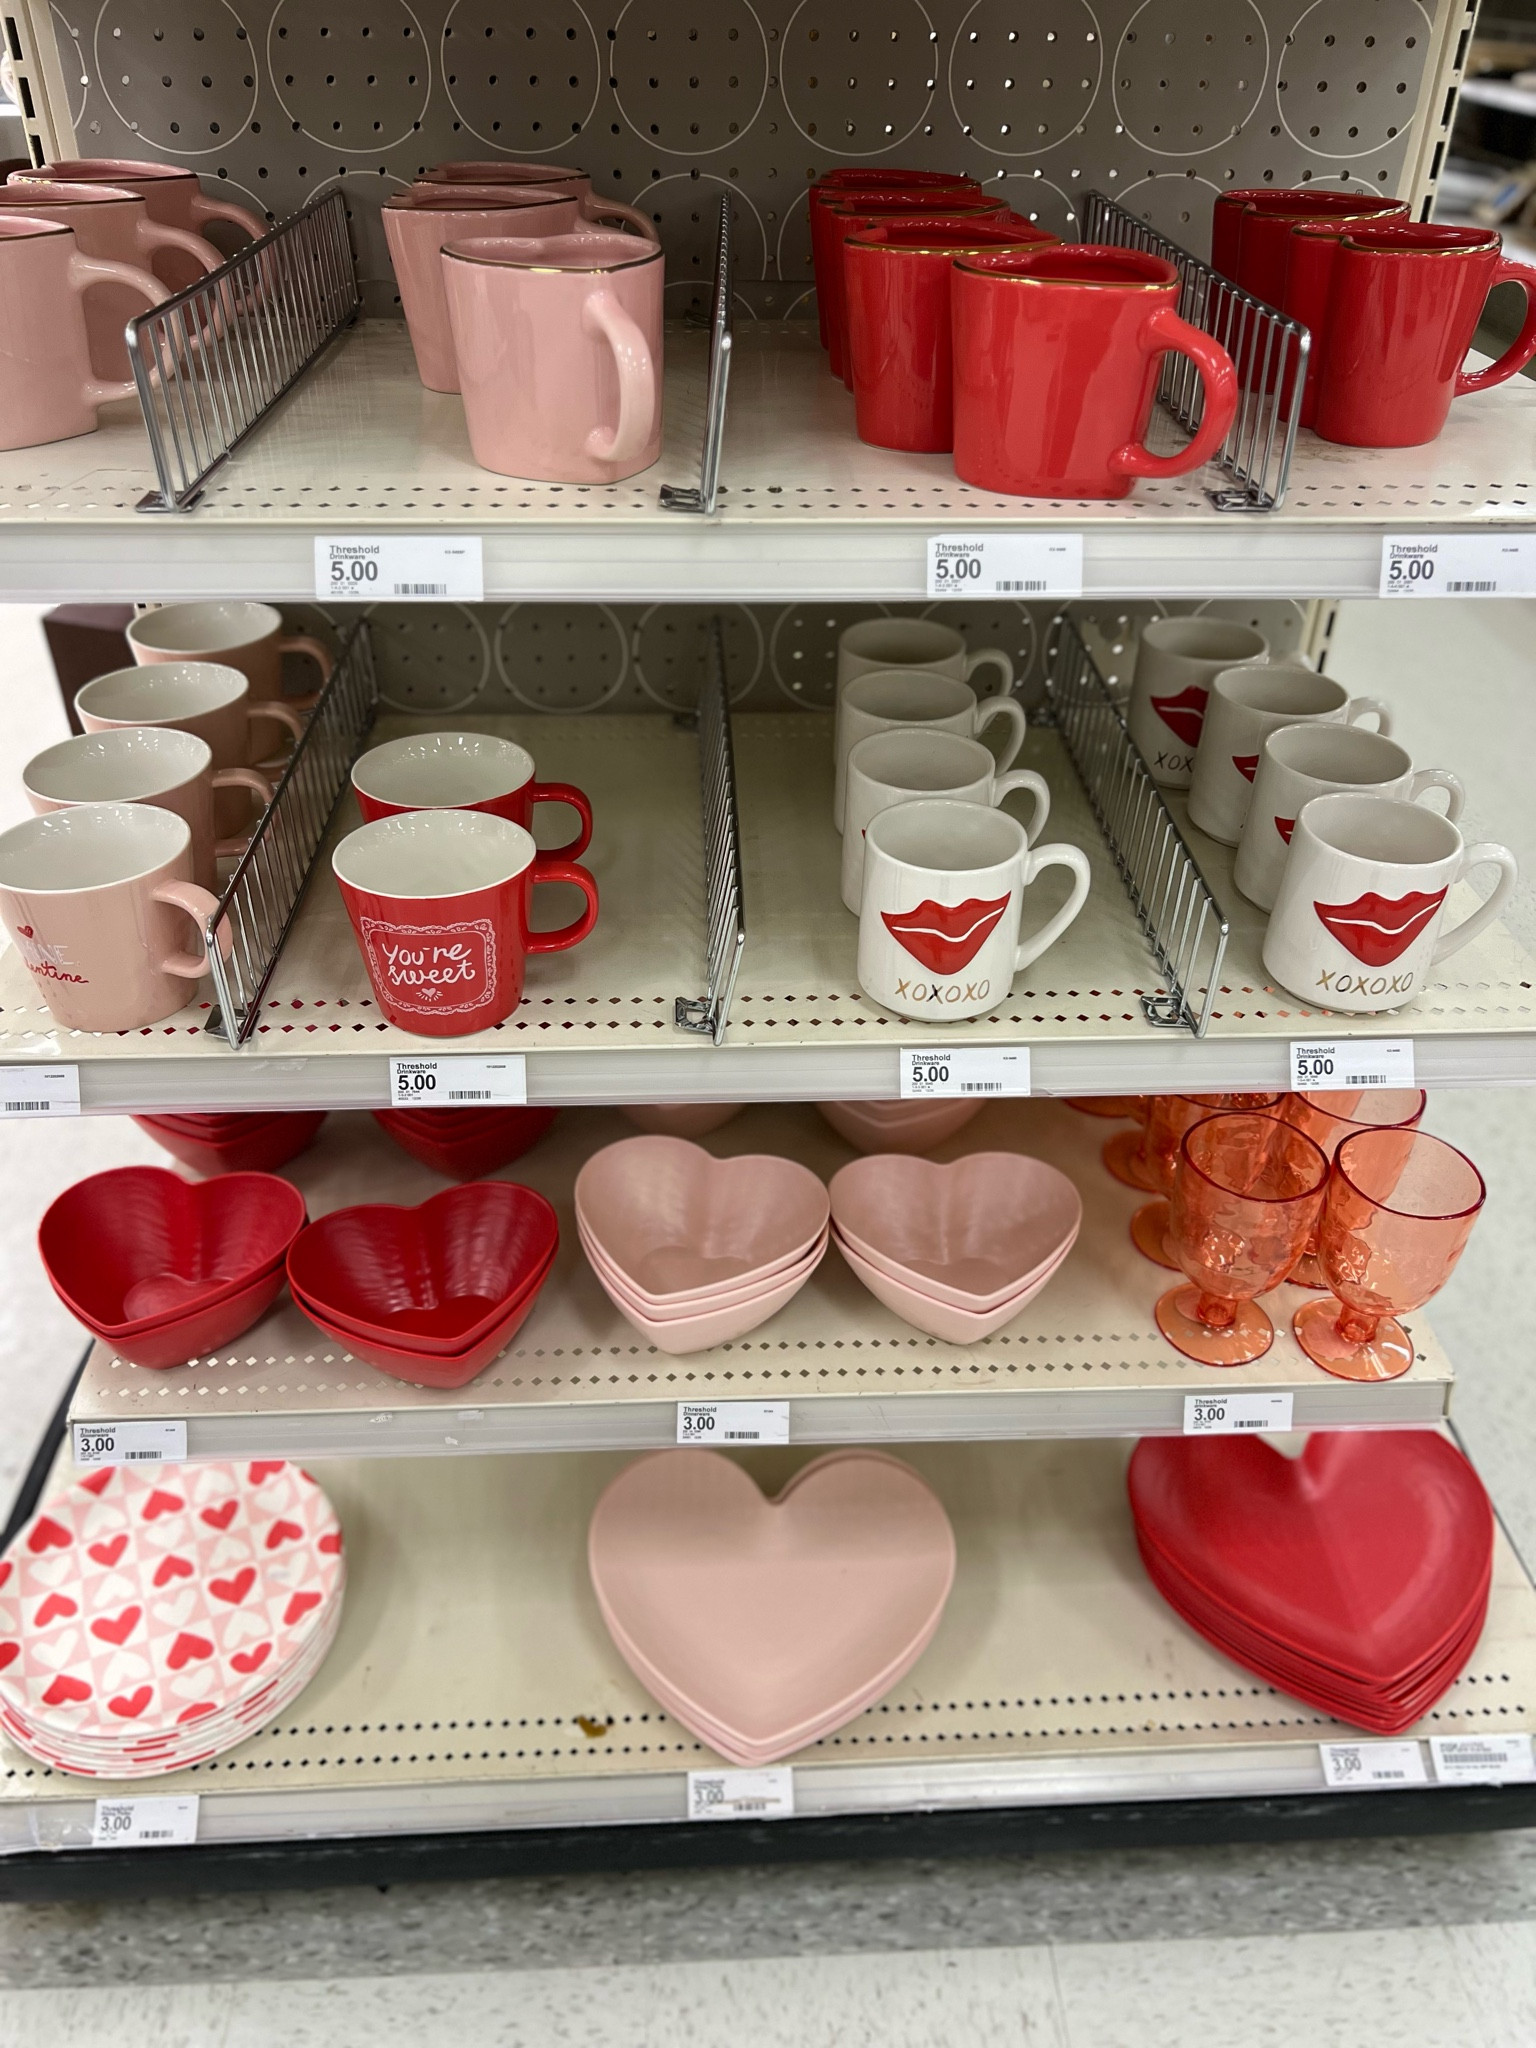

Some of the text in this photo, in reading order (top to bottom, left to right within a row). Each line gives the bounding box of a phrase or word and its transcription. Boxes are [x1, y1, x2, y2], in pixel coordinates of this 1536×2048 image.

[329, 545, 380, 554] Threshold
[935, 543, 984, 552] Threshold
[1390, 544, 1438, 553] Threshold
[331, 560, 378, 582] 5.00
[936, 558, 981, 579] 5.00
[1389, 559, 1434, 580] 5.00
[381, 943, 473, 966] You're
[387, 959, 476, 986] sweet
[1315, 968, 1414, 996] XOXOXO
[894, 978, 990, 1004] XOXOXO
[396, 1062, 438, 1070] Threshold
[912, 1066, 949, 1082] 5.00
[1297, 1059, 1334, 1075] 5.00
[398, 1074, 436, 1090] 5.00
[1194, 1407, 1225, 1421] 3.00
[683, 1416, 715, 1430] 3.00
[81, 1437, 115, 1452] 3.00
[101, 1815, 132, 1831] 3.00
